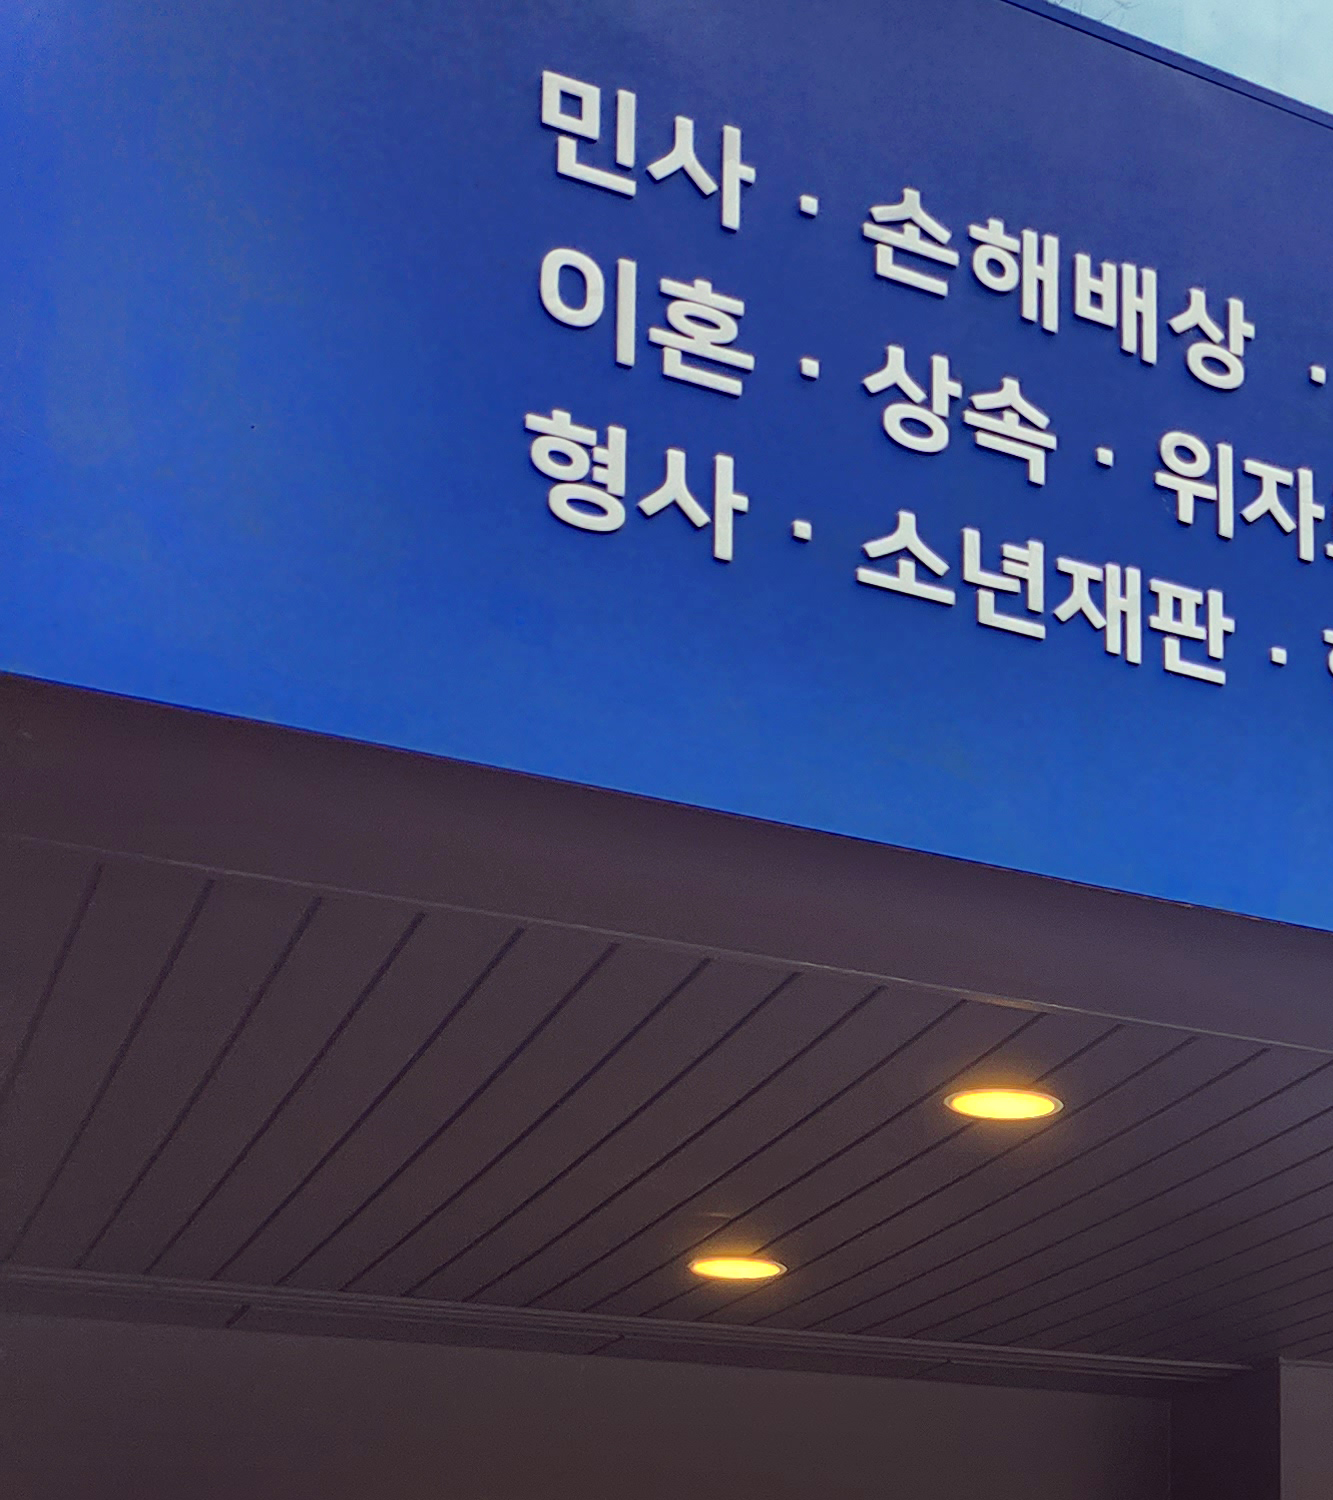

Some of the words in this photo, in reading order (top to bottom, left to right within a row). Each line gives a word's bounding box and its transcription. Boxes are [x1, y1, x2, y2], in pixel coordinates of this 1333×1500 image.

[539, 69, 755, 232] 민사
[861, 187, 1256, 390] 손해배상
[539, 247, 755, 396] 이혼
[864, 343, 1058, 486] 상속
[524, 408, 749, 562] 형사
[856, 510, 1235, 686] 소년재판
